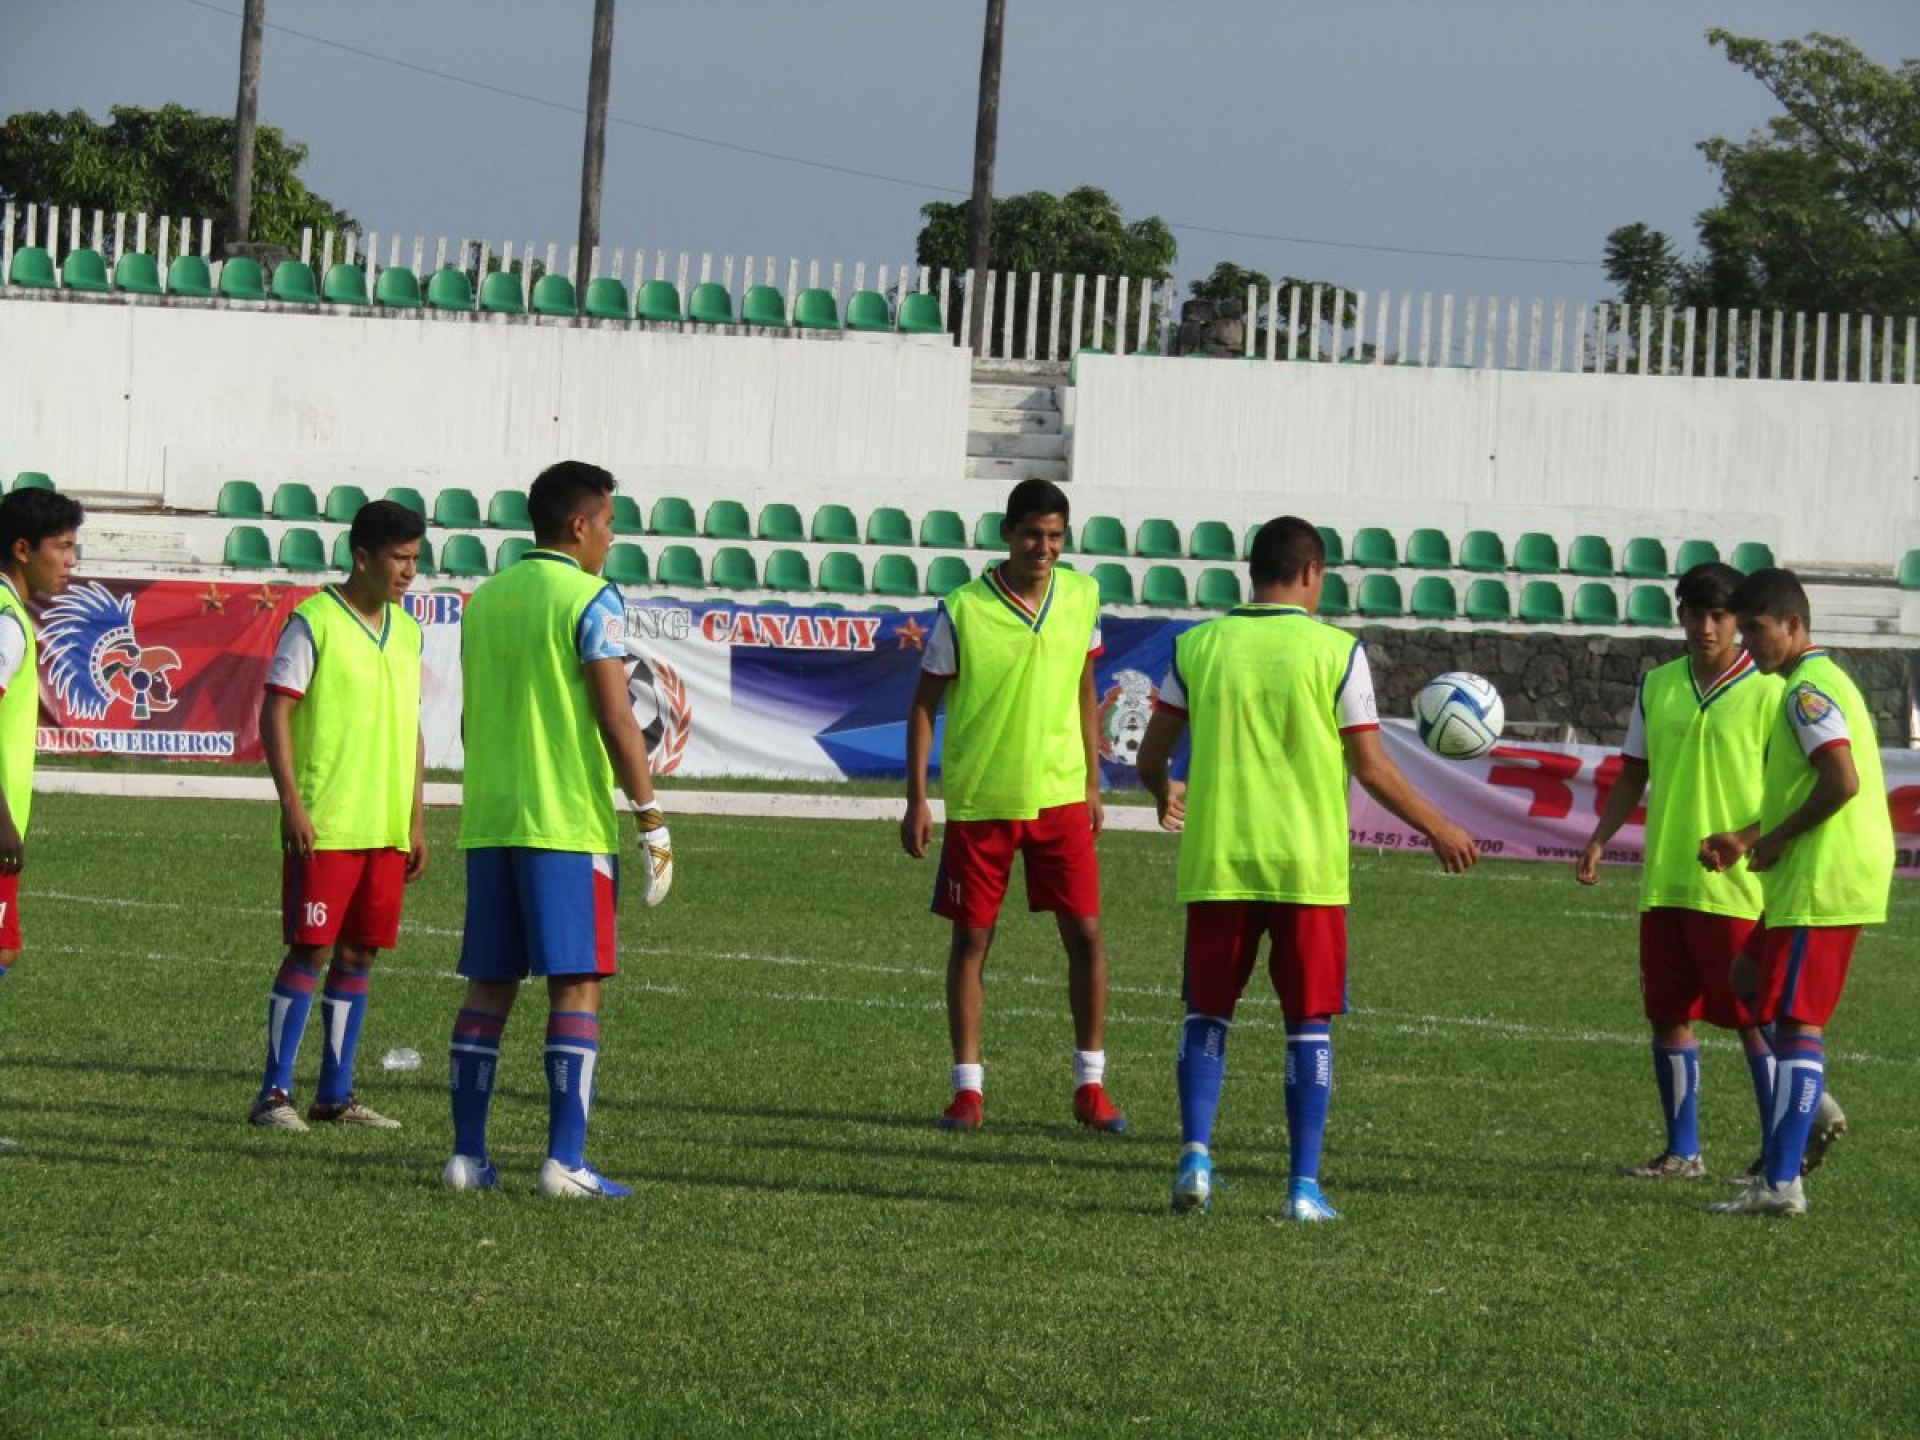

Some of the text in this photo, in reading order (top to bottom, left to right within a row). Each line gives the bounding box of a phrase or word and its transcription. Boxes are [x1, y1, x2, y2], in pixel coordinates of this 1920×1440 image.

[402, 593, 462, 626] UB
[701, 611, 880, 650] CANAMY
[35, 728, 234, 754] OMOSGUERREROS
[303, 901, 328, 927] 16
[1315, 1048, 1329, 1087] CANAMY
[1798, 1075, 1817, 1113] CANAMY
